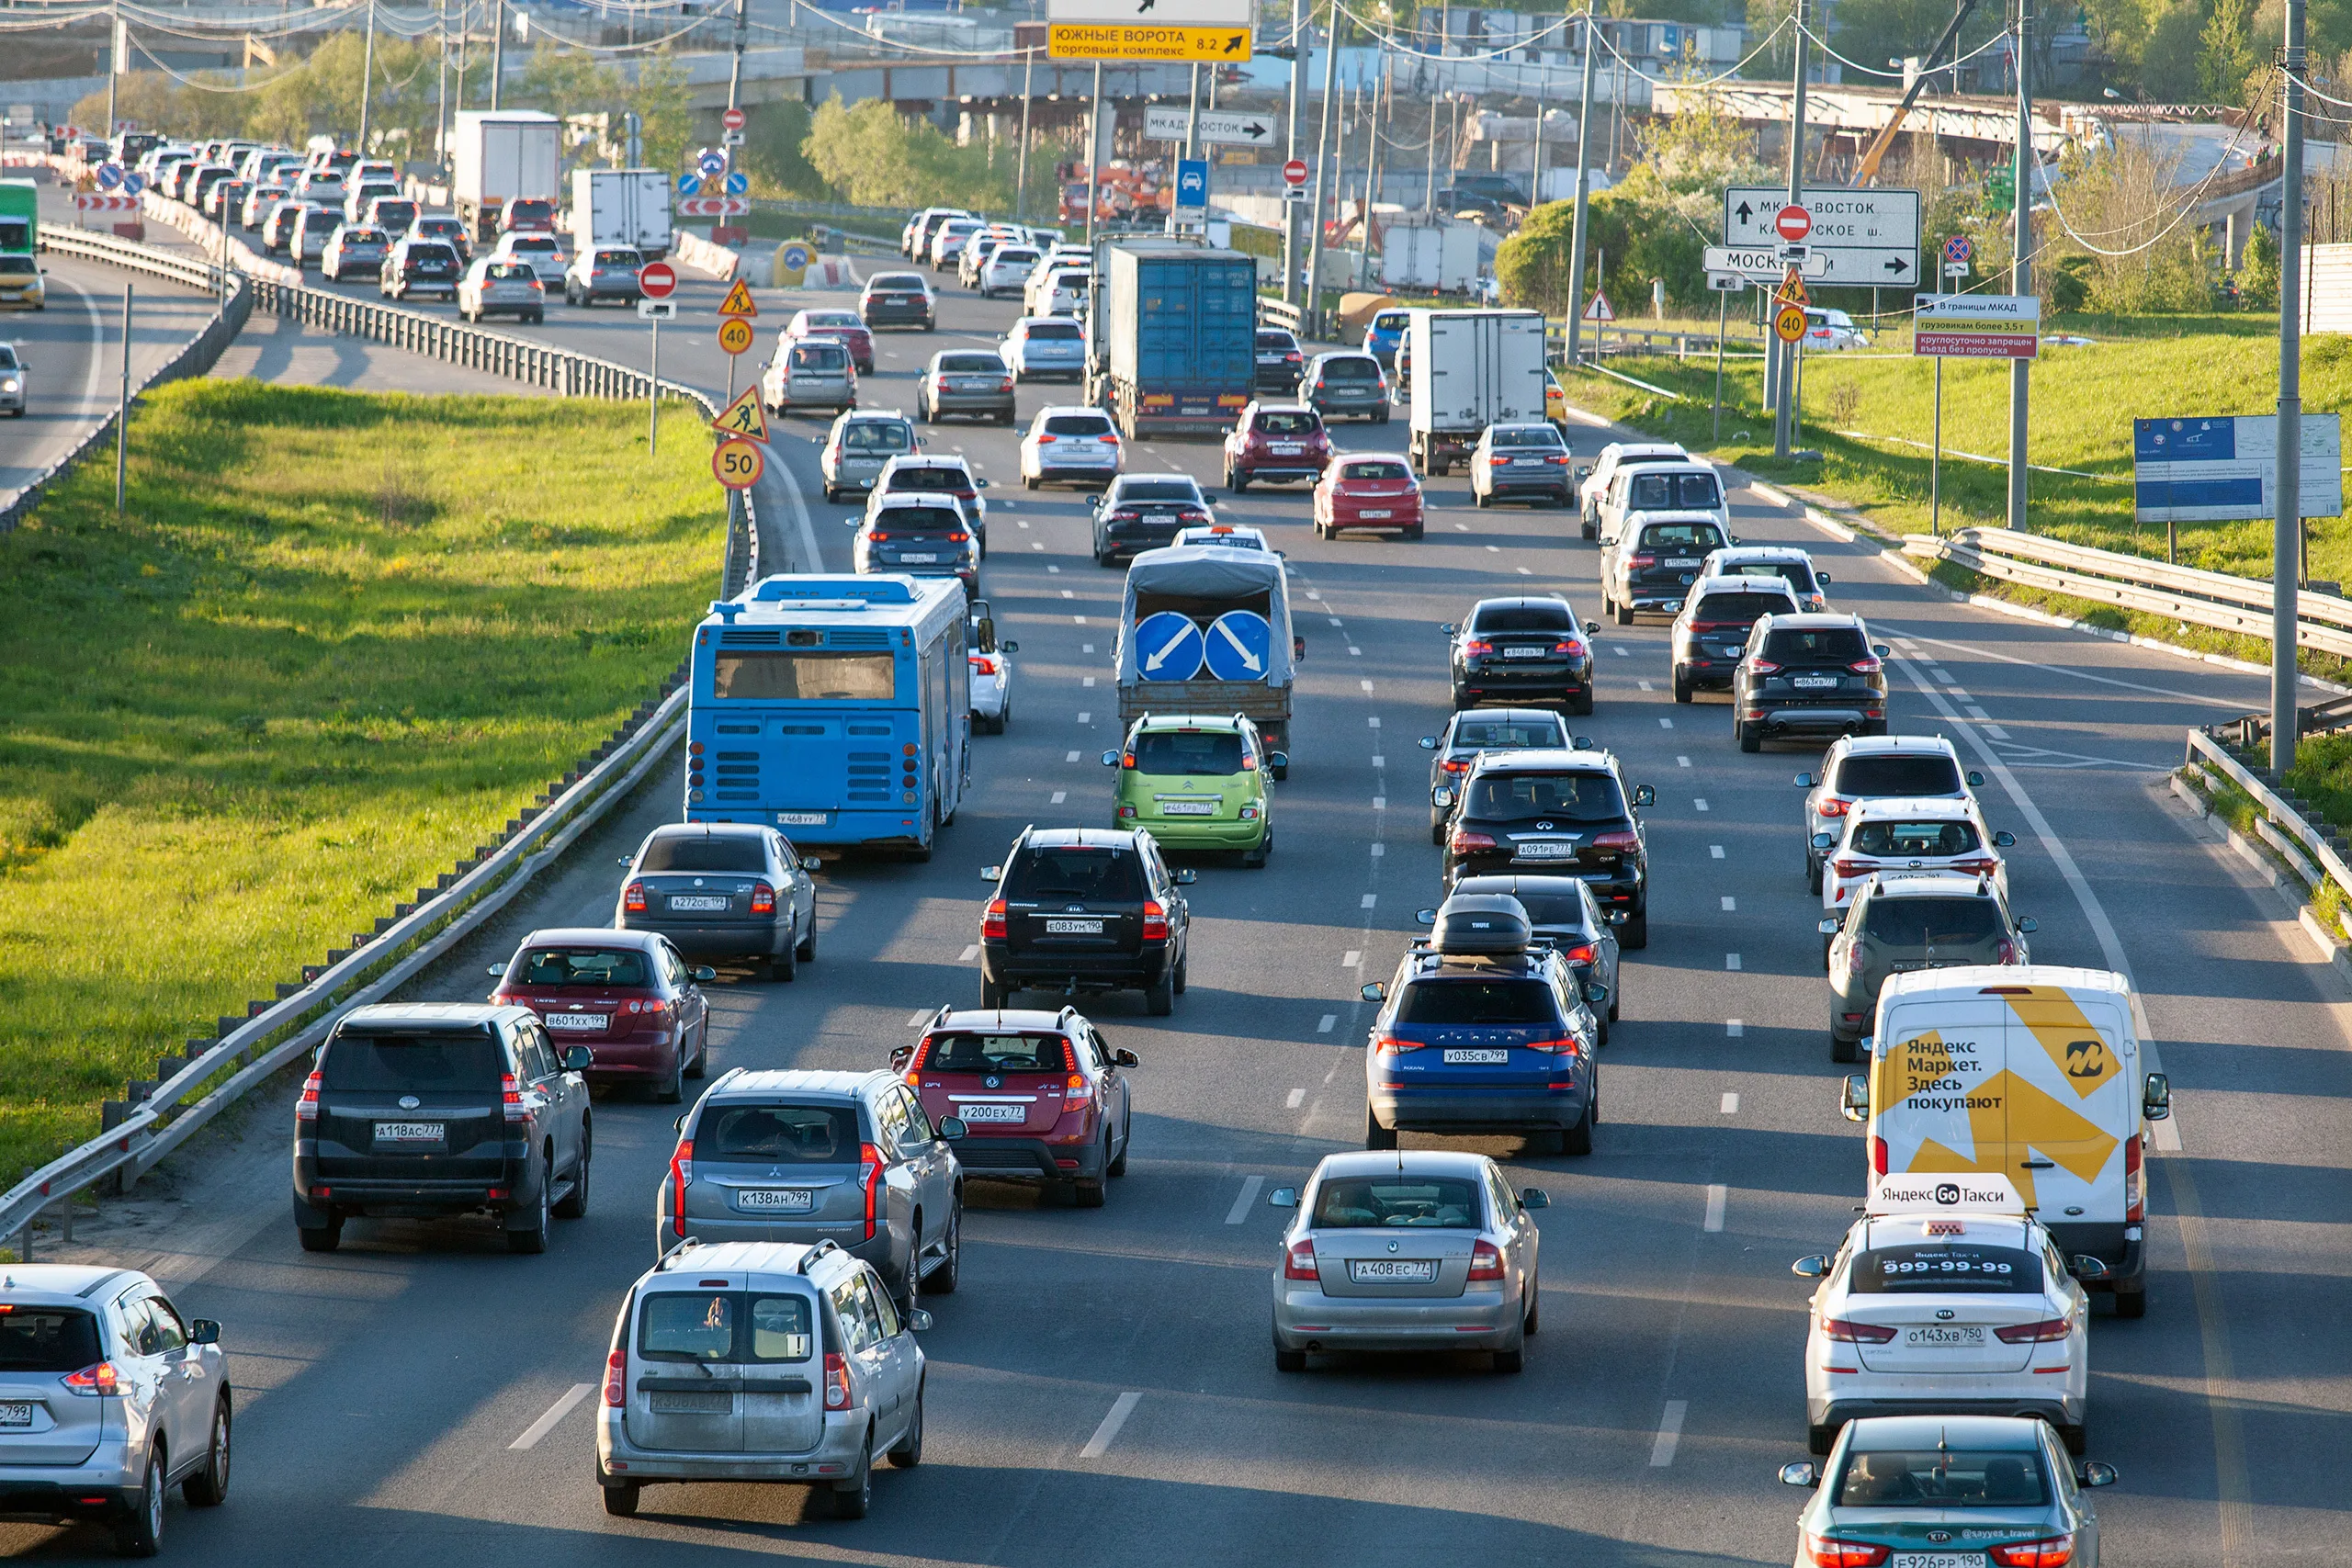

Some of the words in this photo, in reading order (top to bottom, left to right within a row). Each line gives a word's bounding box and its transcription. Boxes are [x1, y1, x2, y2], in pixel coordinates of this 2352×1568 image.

[1056, 28, 1118, 41] ЮЖНЫЕ
[1124, 30, 1185, 43] ВОРОТА
[1197, 38, 1216, 51] 8.2
[1057, 46, 1118, 56] торговый
[1123, 47, 1184, 56] комплекс
[1150, 118, 1239, 133] МКАД-ОСТОК
[1760, 202, 1874, 214] МК-ВОСТОК
[1867, 227, 1883, 237] ш.
[1726, 253, 1803, 271] МОСК
[1988, 303, 2018, 312] МКАД
[1781, 317, 1801, 331] 40
[1921, 321, 1973, 330] грузовикам
[1975, 321, 2002, 331] более
[2004, 323, 2018, 332] 3,5
[726, 329, 745, 344] 40
[1920, 336, 1985, 345] круглосуточно
[1987, 338, 2032, 347] запрещен
[1920, 345, 1947, 354] въезд
[1966, 347, 2007, 355] пропуска
[725, 454, 752, 473] 50
[781, 814, 813, 823] У468УУ
[1521, 844, 1555, 854] А091РЕ
[673, 897, 708, 908] А272ОЕ
[710, 897, 724, 906] 199
[1049, 921, 1085, 931] Е083УМ
[1086, 921, 1100, 930] 190
[548, 1015, 588, 1026] В601ХХ
[590, 1016, 605, 1024] 199
[1907, 1040, 1976, 1056] Яндекс
[1447, 1050, 1488, 1062] У035СВ
[1489, 1049, 1505, 1058] 799
[1907, 1058, 1982, 1075] Маркет.
[1907, 1076, 1962, 1093] Здесь
[1907, 1097, 2002, 1112] покупают
[963, 1107, 1007, 1118] У200ЕХ
[1010, 1107, 1021, 1115] 77
[379, 1125, 423, 1136] А118АС
[424, 1125, 441, 1134] 777
[742, 1192, 788, 1204] К138АН
[790, 1192, 808, 1202] 799
[1883, 1188, 1933, 1202] Яндекс
[1937, 1186, 1959, 1201] Go
[1962, 1188, 2004, 1202] Такси
[1915, 1251, 1949, 1259] Яндекс
[1360, 1262, 1410, 1275] А408ЕС
[1414, 1262, 1427, 1272] 77
[1883, 1261, 2012, 1274] 999-99-99
[1909, 1329, 1960, 1342] О143ХВ
[1962, 1328, 1982, 1338] 750
[6, 1406, 28, 1416] 799
[1962, 1529, 2035, 1539] @sayyes_travel
[1897, 1555, 1956, 1568] Е926РР
[1960, 1554, 1982, 1567] 190
